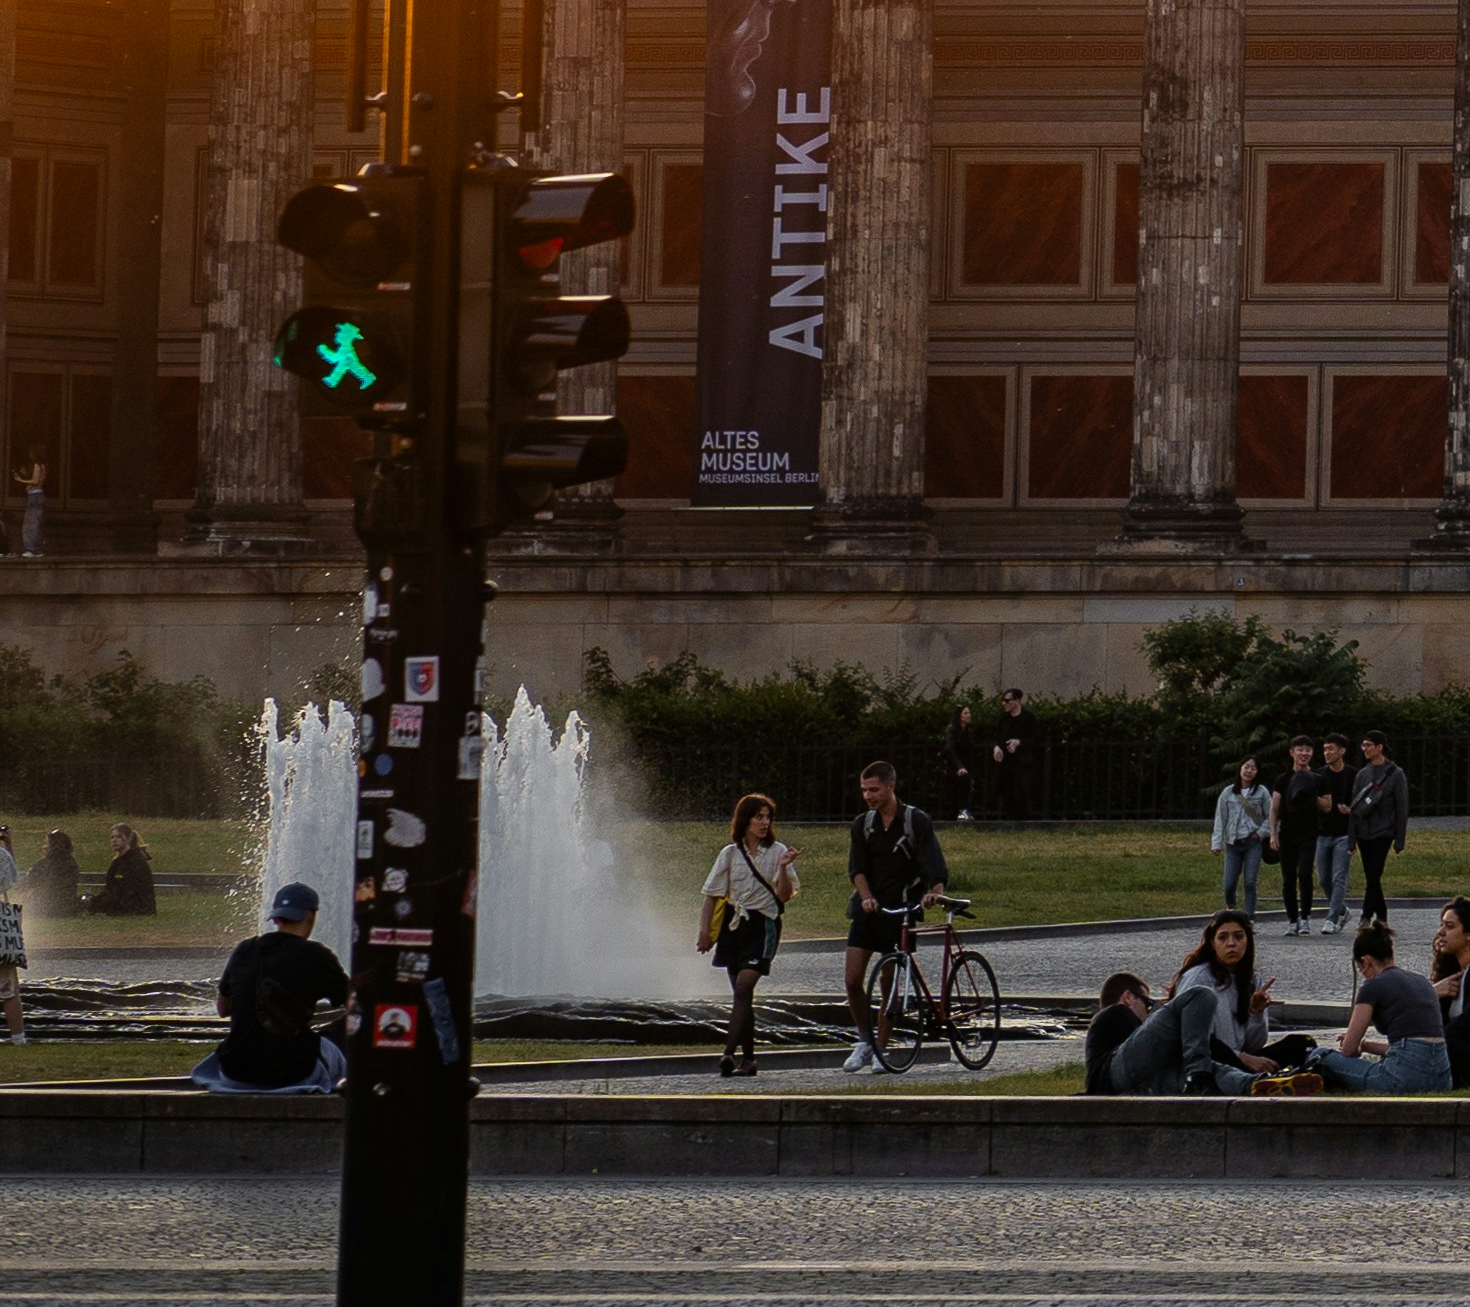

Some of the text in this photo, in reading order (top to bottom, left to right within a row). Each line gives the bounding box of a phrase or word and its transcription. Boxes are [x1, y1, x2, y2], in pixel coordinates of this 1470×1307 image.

[768, 87, 831, 360] ANTIKE
[701, 431, 759, 449] ALTES
[701, 452, 790, 471] MUSEUM
[699, 473, 782, 484] MUSEUMSINSEL
